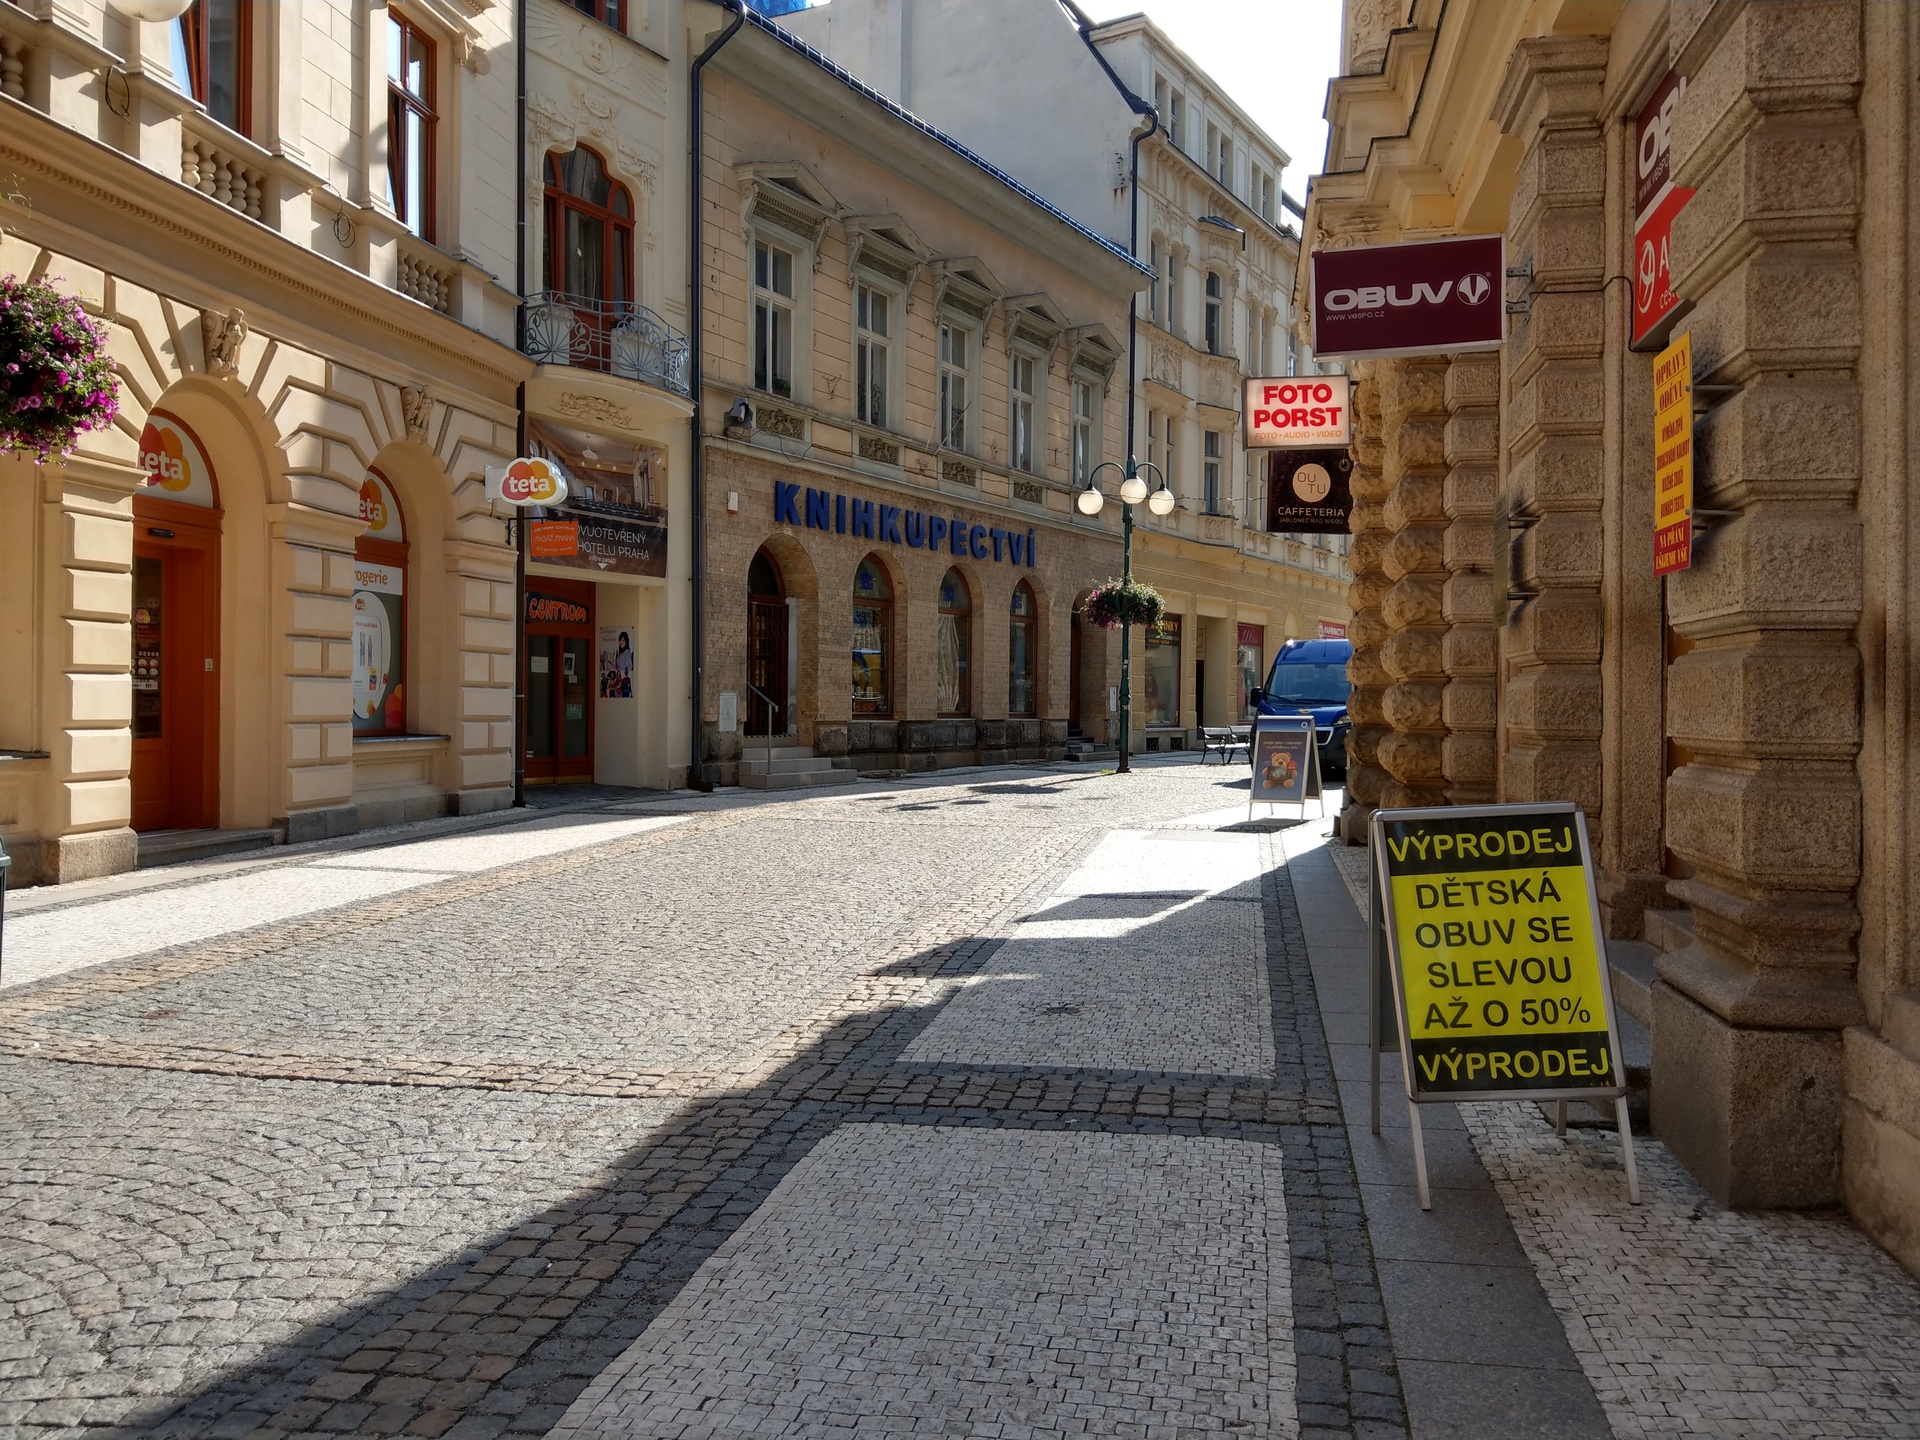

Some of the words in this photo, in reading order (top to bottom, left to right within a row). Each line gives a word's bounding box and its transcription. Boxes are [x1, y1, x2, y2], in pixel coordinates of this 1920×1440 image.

[1639, 76, 1687, 180] OB
[1324, 281, 1453, 311] OBUV
[1655, 347, 1687, 386] OPRAVY
[1264, 383, 1332, 405] FOTO
[1254, 407, 1342, 429] PORST
[1254, 432, 1278, 440] FOTO
[1283, 431, 1310, 439] AUDIO
[1316, 430, 1342, 438] VIDEO
[508, 475, 551, 493] teta
[1297, 472, 1316, 483] OU
[1307, 483, 1326, 495] TU
[358, 498, 383, 521] eta
[1277, 507, 1345, 517] CAFFETERIA
[774, 480, 1036, 568] KNIHKUPECTVÍ
[618, 546, 649, 560] PRAHA
[354, 570, 388, 587] ogerie
[1388, 826, 1573, 862] VÝPRODEJ
[1415, 871, 1561, 909] DĚTSKÁ
[1415, 918, 1516, 948] OBUV
[1527, 916, 1574, 943] SE
[1427, 956, 1572, 989] SLEVOU
[1424, 996, 1473, 1030] AŽ
[1482, 1000, 1510, 1027] O
[1521, 997, 1591, 1026] 50%
[1418, 1047, 1609, 1082] VÝPRODEJ
